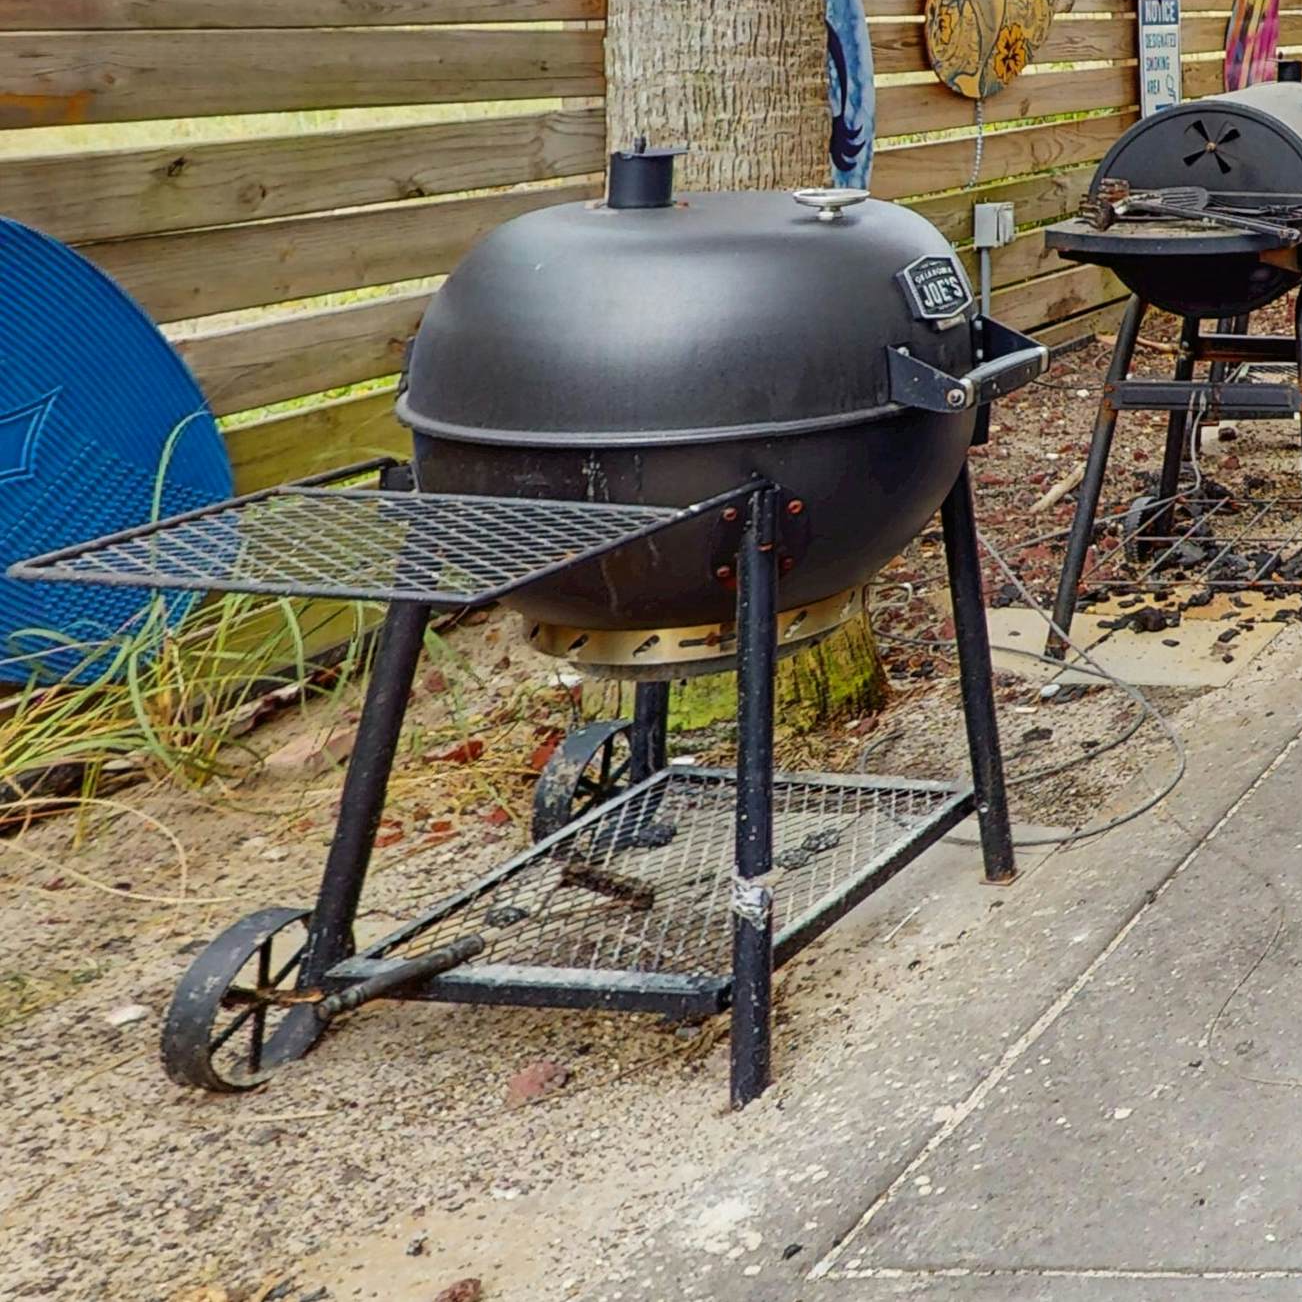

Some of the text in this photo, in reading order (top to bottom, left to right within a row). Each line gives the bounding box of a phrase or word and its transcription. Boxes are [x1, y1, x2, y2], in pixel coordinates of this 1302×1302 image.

[1144, 0, 1176, 23] NOTICE
[1144, 33, 1177, 49] DESIGNATED
[1145, 55, 1171, 72] SMOKING
[1146, 78, 1161, 95] AREA
[922, 275, 964, 308] JOE'S
